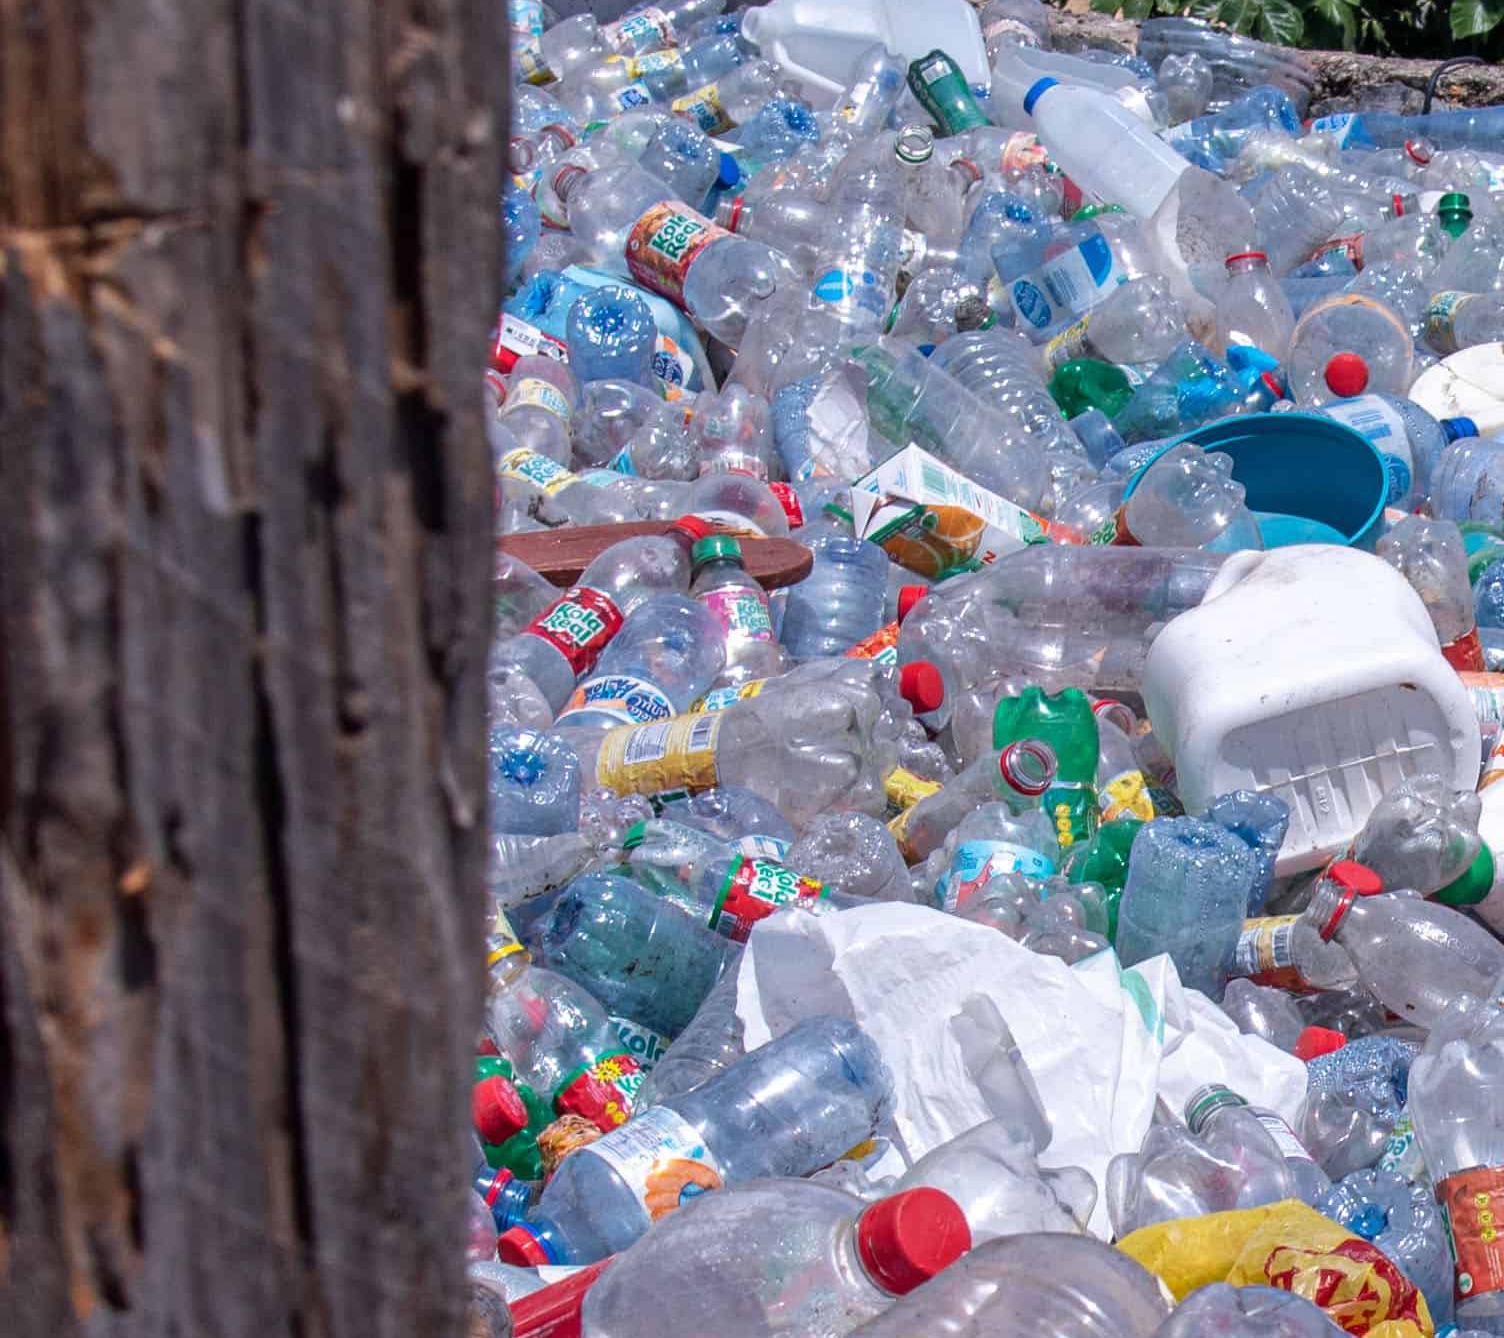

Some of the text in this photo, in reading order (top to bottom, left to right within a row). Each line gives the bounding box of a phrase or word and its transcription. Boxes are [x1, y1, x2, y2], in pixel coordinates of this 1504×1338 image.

[659, 214, 689, 251] Kola
[668, 221, 706, 262] Real
[546, 612, 596, 644] Real
[555, 603, 603, 633] Kola
